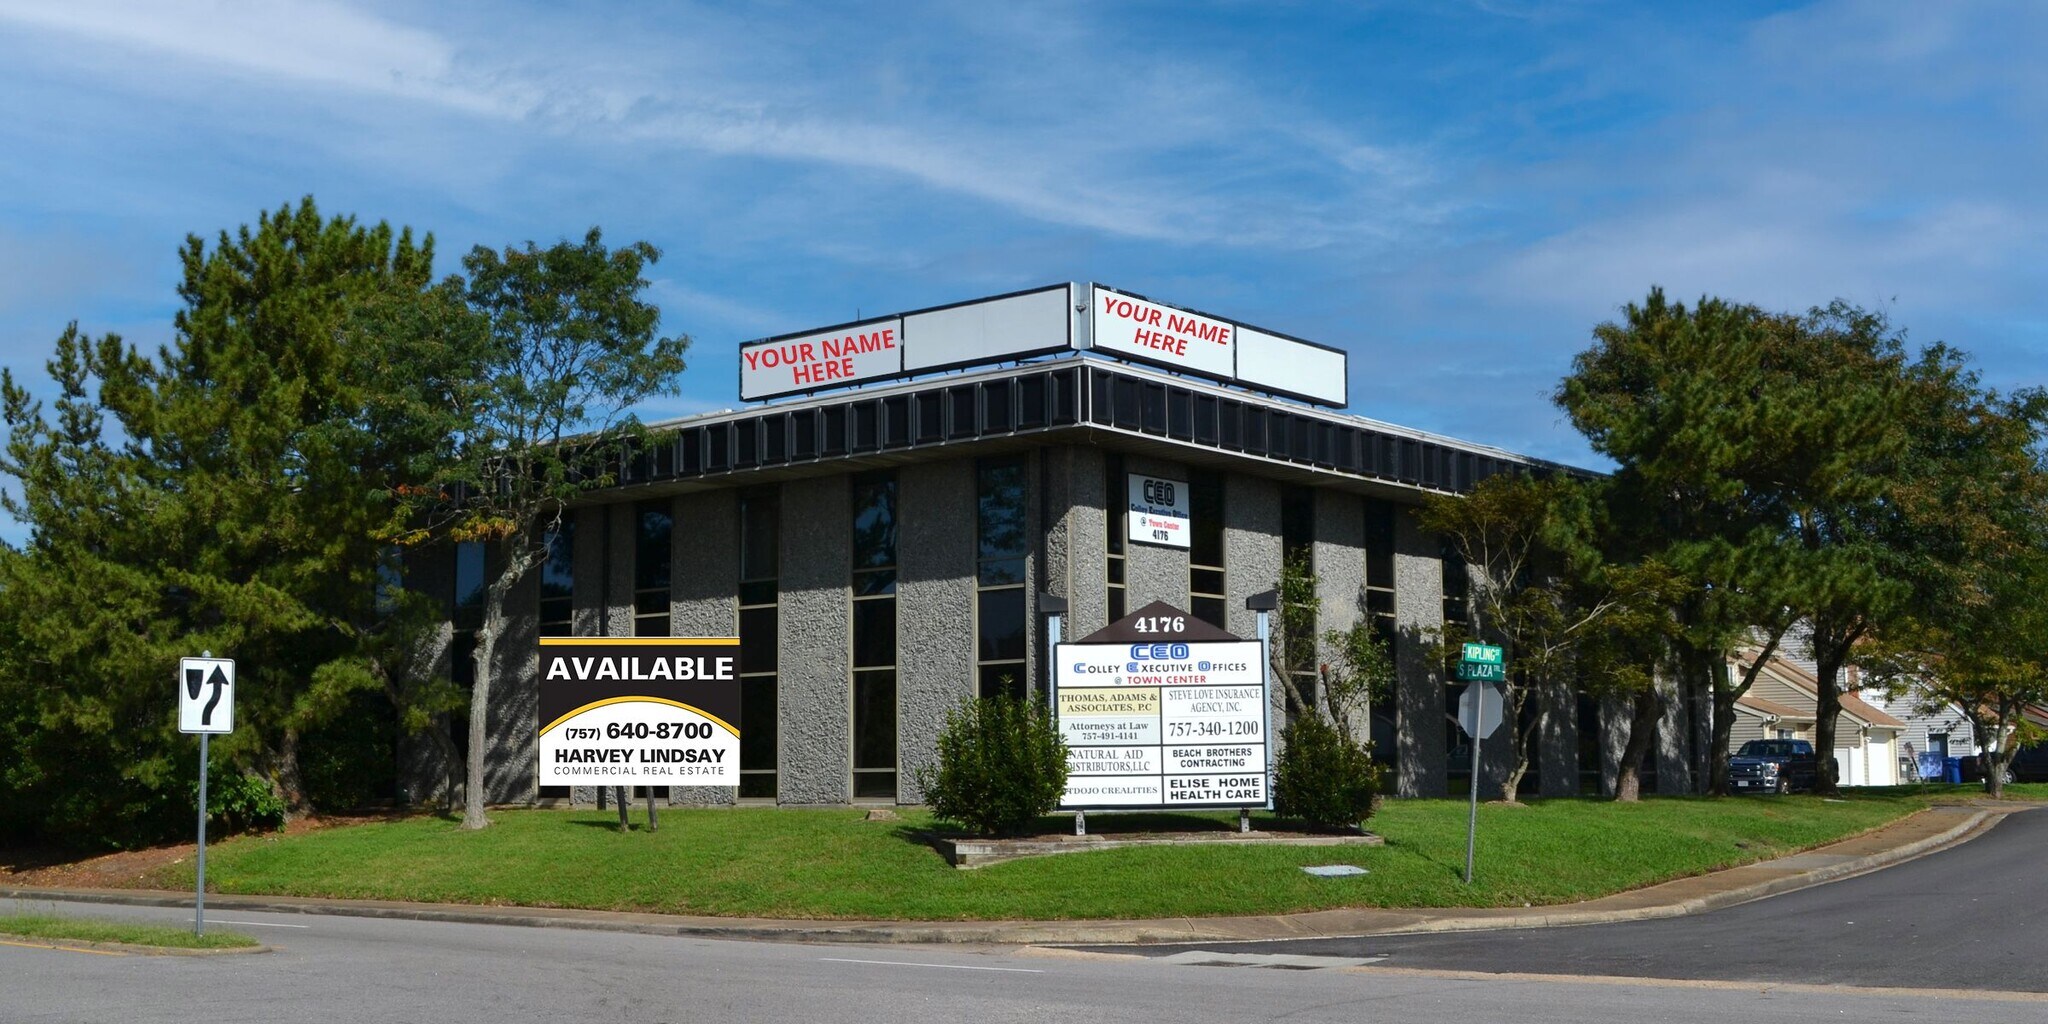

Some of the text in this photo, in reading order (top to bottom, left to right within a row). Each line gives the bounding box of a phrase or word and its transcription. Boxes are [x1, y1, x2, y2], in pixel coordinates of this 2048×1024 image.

[1105, 297, 1230, 345] YOUR NAME
[1134, 328, 1188, 356] HERE
[744, 329, 895, 370] YOUR NAME
[793, 358, 855, 385] HERE
[1144, 480, 1175, 507] CEO
[1148, 518, 1163, 528] Town
[1163, 520, 1180, 530] Center
[1152, 529, 1169, 541] 4176
[1134, 616, 1185, 633] 4176
[1130, 643, 1190, 661] CEO
[1467, 646, 1495, 661] KIPLING
[546, 656, 734, 681] AVAILABLE
[1073, 660, 1247, 674] COLLEY EXECUTIVE OFFICES
[1459, 664, 1464, 676] S
[1468, 665, 1493, 677] PLAZA
[1127, 676, 1162, 685] TOWN
[1166, 675, 1207, 684] CENTER
[1059, 693, 1158, 702] THOMAS, ADAMS &
[1168, 688, 1260, 700] STEVE LOVE INSURANCE
[1066, 704, 1136, 712] ASSOCIATES,
[1190, 702, 1242, 713] AGENCY, INC.
[565, 722, 713, 741] (757) 640-8700
[1069, 722, 1149, 732] Attorneys at Law
[1168, 720, 1259, 737] 757-340-1200
[1082, 732, 1138, 740] 757-491-4141
[555, 748, 726, 763] HARVEY LINDSAY
[1068, 749, 1144, 760] NATURAL AID
[1172, 748, 1252, 758] BEACH BROTHERS
[1180, 758, 1245, 768] CONTRACTING
[554, 766, 725, 775] COMMERCIAL REAL ESTATE
[1170, 778, 1260, 788] ELISE HOME
[1101, 786, 1158, 794] CREALITIES
[1170, 789, 1260, 800] HEALTH CARE
